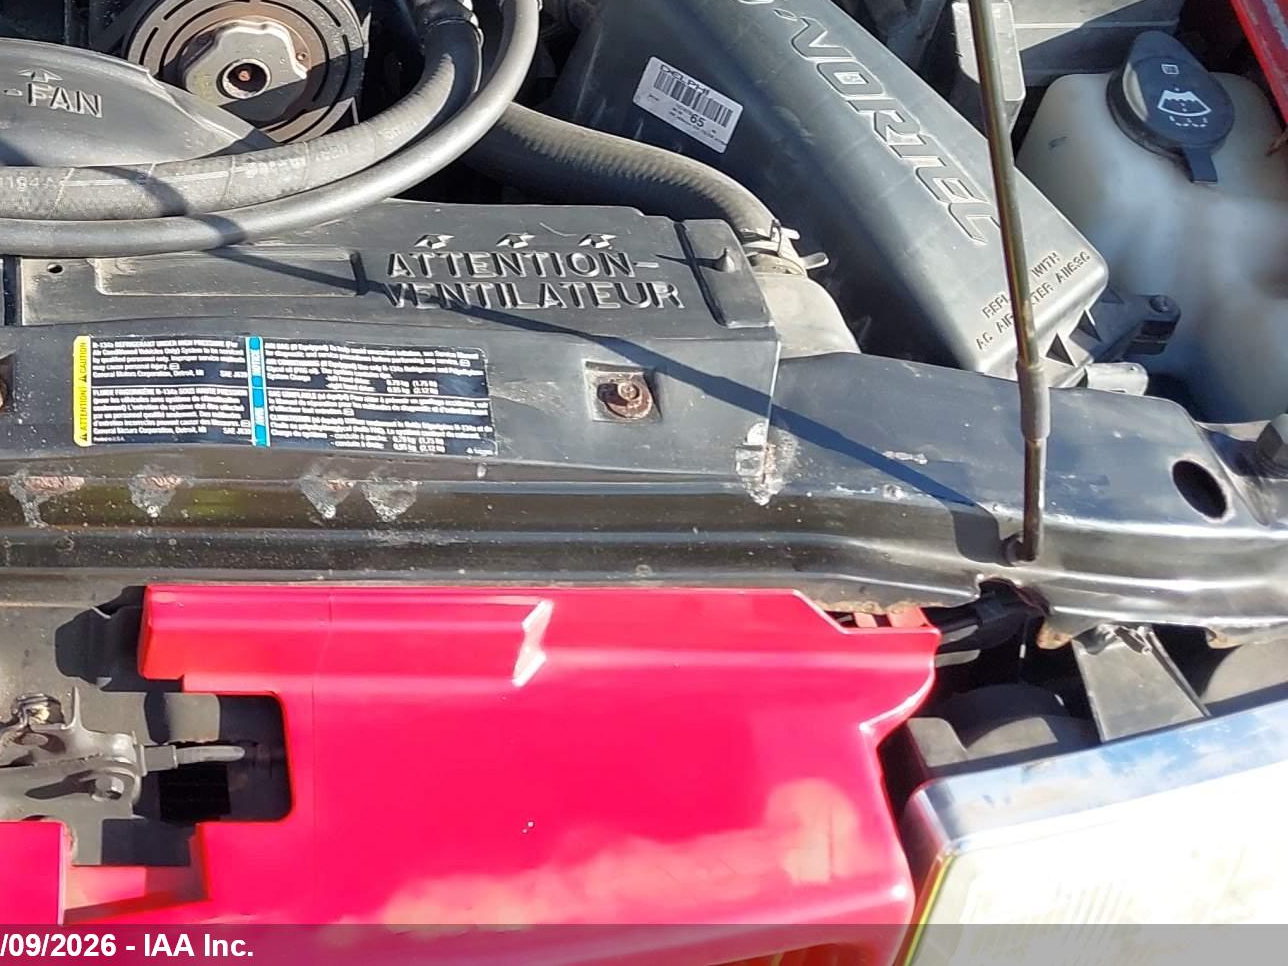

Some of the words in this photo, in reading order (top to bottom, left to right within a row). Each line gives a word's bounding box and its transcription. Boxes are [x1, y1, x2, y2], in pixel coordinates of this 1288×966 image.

[690, 114, 705, 127] 65
[1031, 252, 1060, 278] WITH
[384, 282, 685, 309] VENTILATEUR
[79, 342, 87, 373] CAUTION
